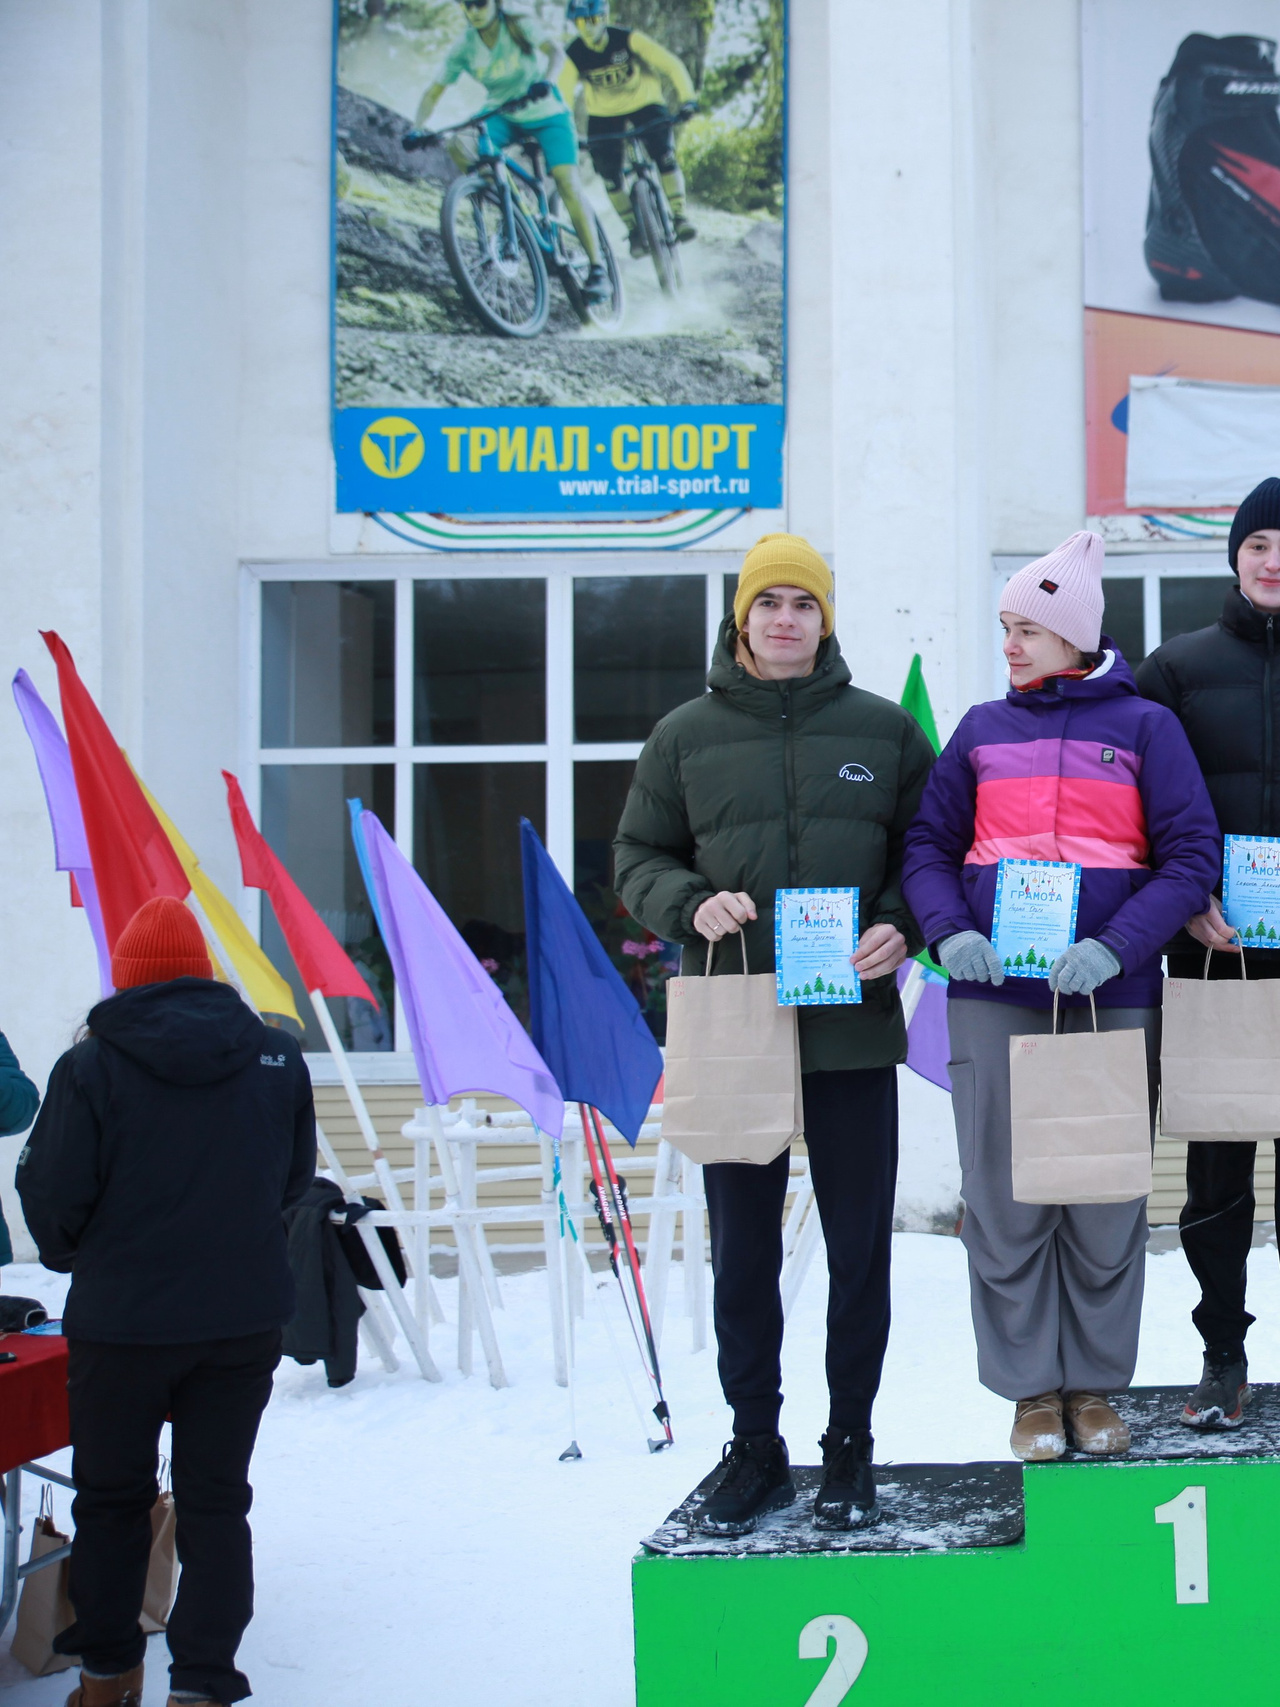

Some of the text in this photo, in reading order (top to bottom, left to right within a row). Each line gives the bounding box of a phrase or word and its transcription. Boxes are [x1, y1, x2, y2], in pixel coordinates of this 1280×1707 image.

[559, 475, 750, 499] www.trial-sport.ru
[1010, 890, 1063, 902] ГРАМОТА
[790, 919, 844, 929] ГРАМОТА
[597, 1185, 613, 1224] NORDWAY
[612, 1183, 628, 1220] NORDWAY
[1154, 1485, 1210, 1605] 1
[798, 1614, 869, 1707] 2
